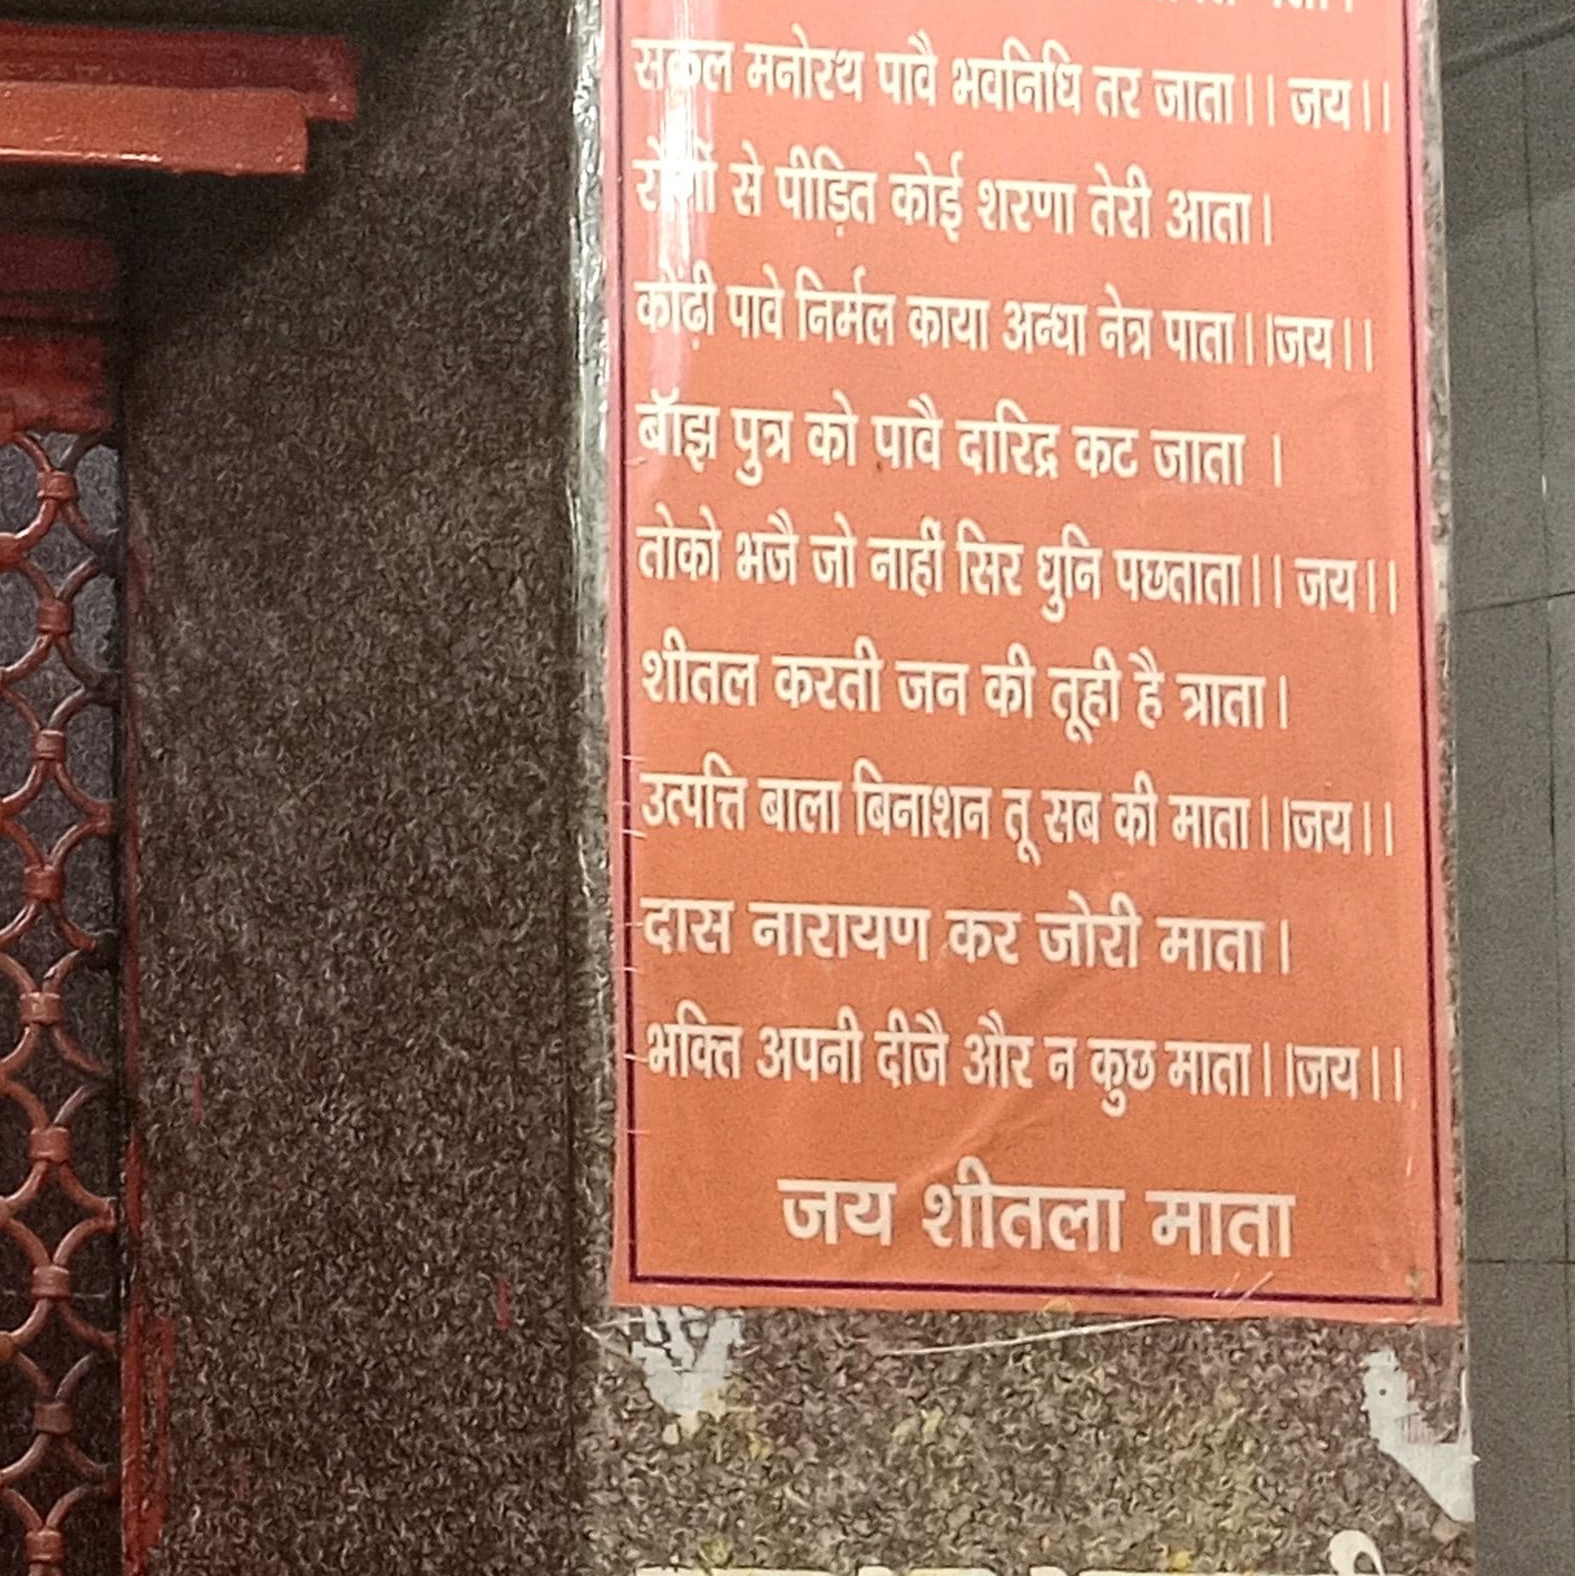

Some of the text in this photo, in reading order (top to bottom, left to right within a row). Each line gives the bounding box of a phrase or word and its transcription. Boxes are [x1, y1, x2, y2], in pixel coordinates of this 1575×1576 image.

[742, 22, 1084, 116] मनोरथ पावै भवनिधि
[727, 138, 1153, 243] से पीड़ित कोई शरणा तेरी
[724, 262, 1154, 361] पावे निर्मल काया अन्धा नेत्र
[729, 406, 794, 487] पुत्र
[802, 388, 860, 467] को
[869, 391, 944, 471] पावै
[953, 397, 1062, 479] दारिद्र
[1070, 424, 1140, 479] कट
[1148, 428, 1246, 486] जाता
[637, 500, 723, 584] तोको
[734, 506, 800, 586] भजै
[808, 509, 858, 589] जो
[865, 515, 945, 598] नाहीं
[955, 517, 1025, 596] सिर
[1035, 521, 1104, 623] धुनि
[640, 625, 1165, 746] शीतल करती जन की तूही है
[640, 750, 1159, 867] उत्पत्ति बाला बिनाशन तू सब की
[642, 896, 735, 955] दास
[747, 900, 933, 963] नारायण
[939, 908, 1023, 966] कर
[1033, 888, 1143, 970] जोरी
[645, 998, 1157, 1117] भक्ति अपनी दीजै और कुछ
[775, 1155, 1297, 1258] जय शीतला माता
